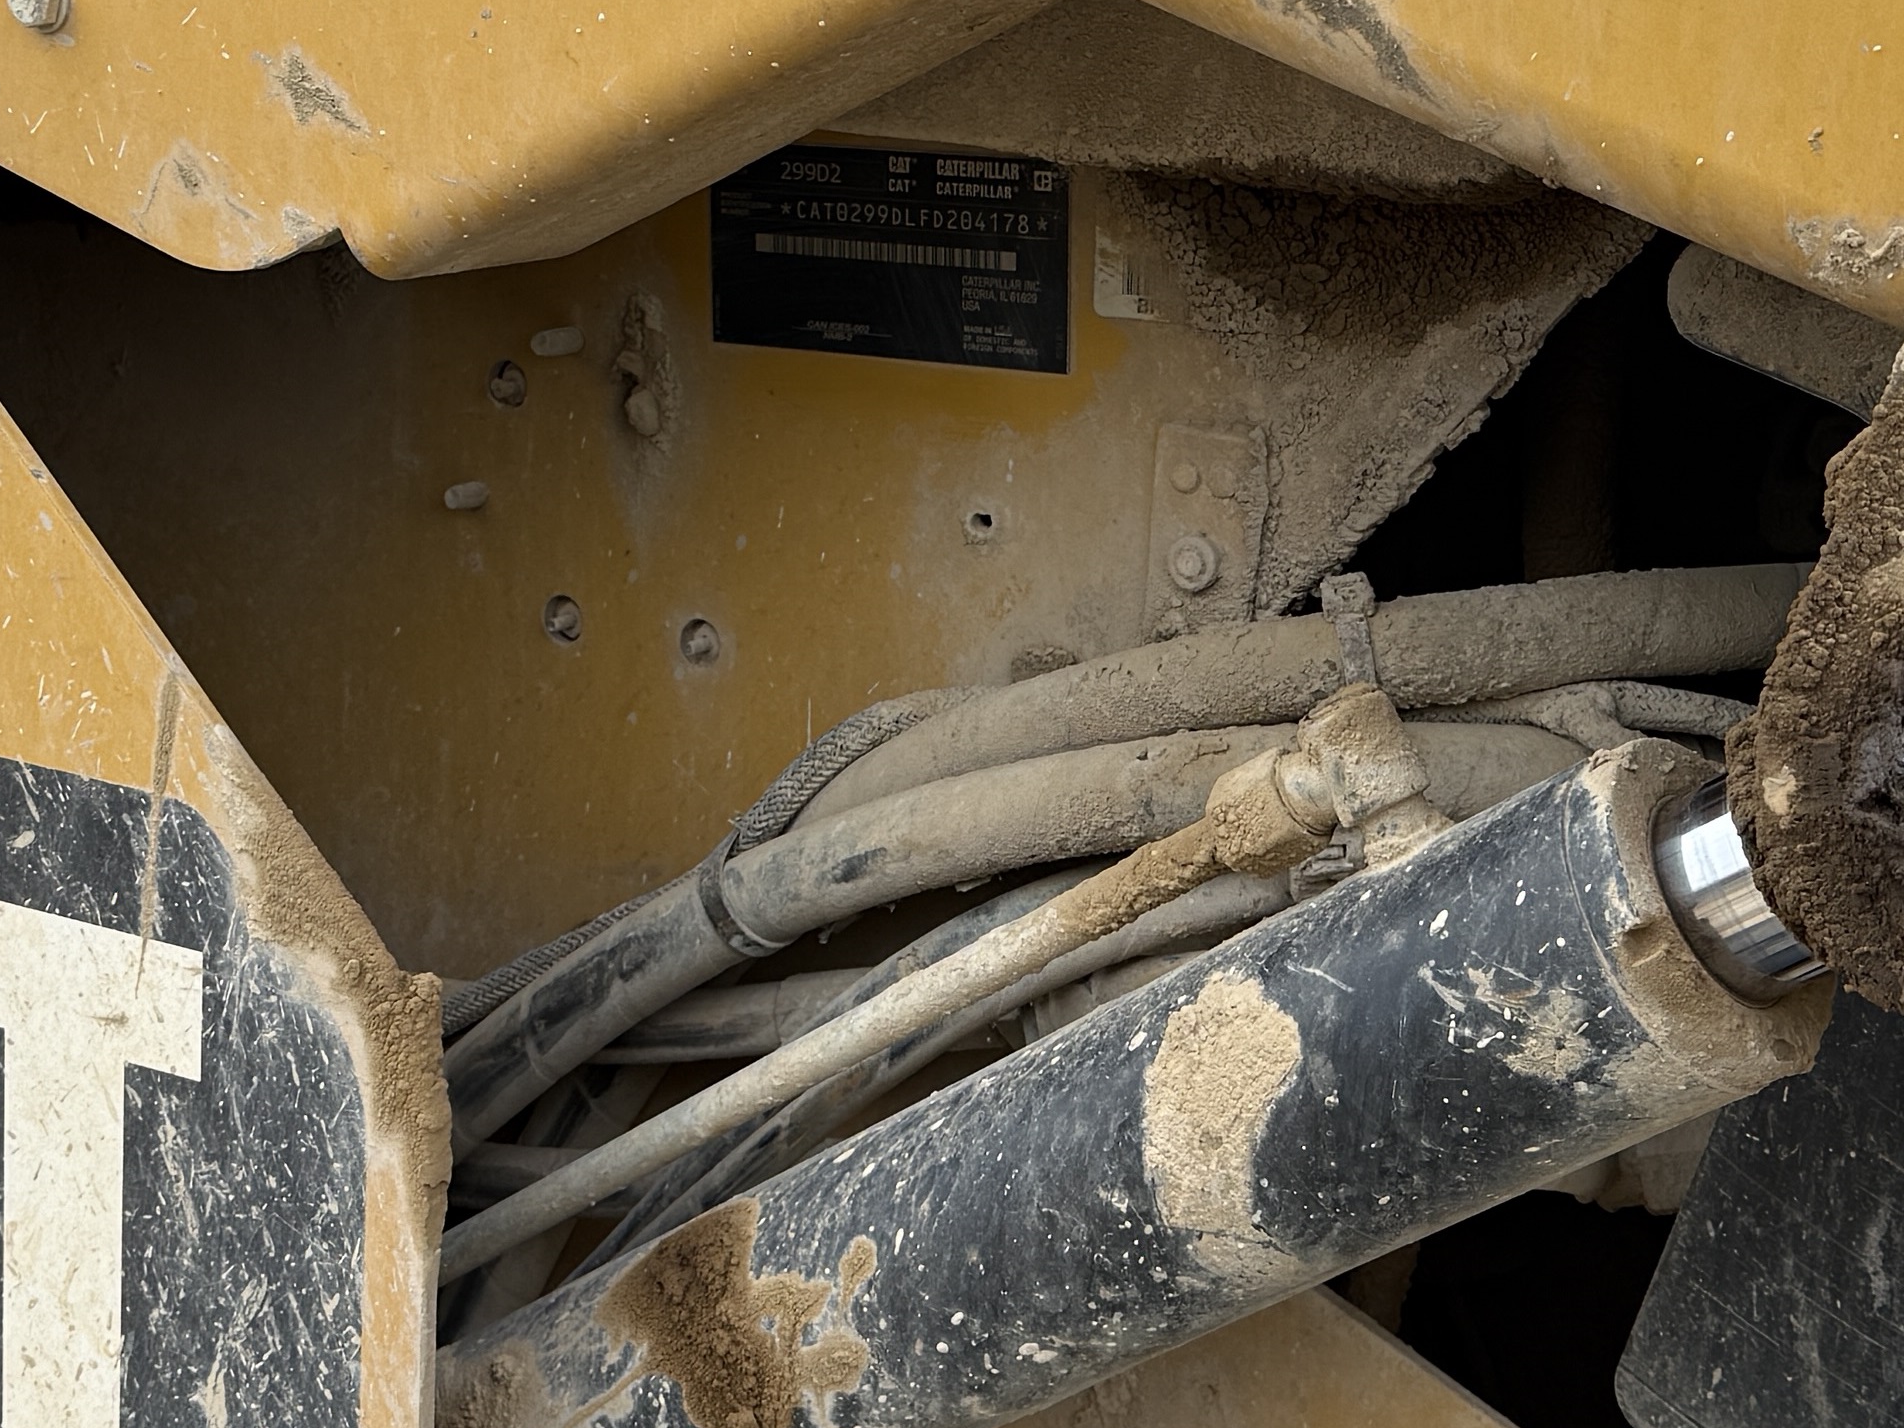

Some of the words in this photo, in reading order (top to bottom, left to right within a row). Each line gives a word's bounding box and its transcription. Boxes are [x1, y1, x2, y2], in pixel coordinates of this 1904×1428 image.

[780, 161, 842, 183] 299D2
[961, 275, 1022, 292] CATERPILLAR
[961, 300, 981, 312] USA
